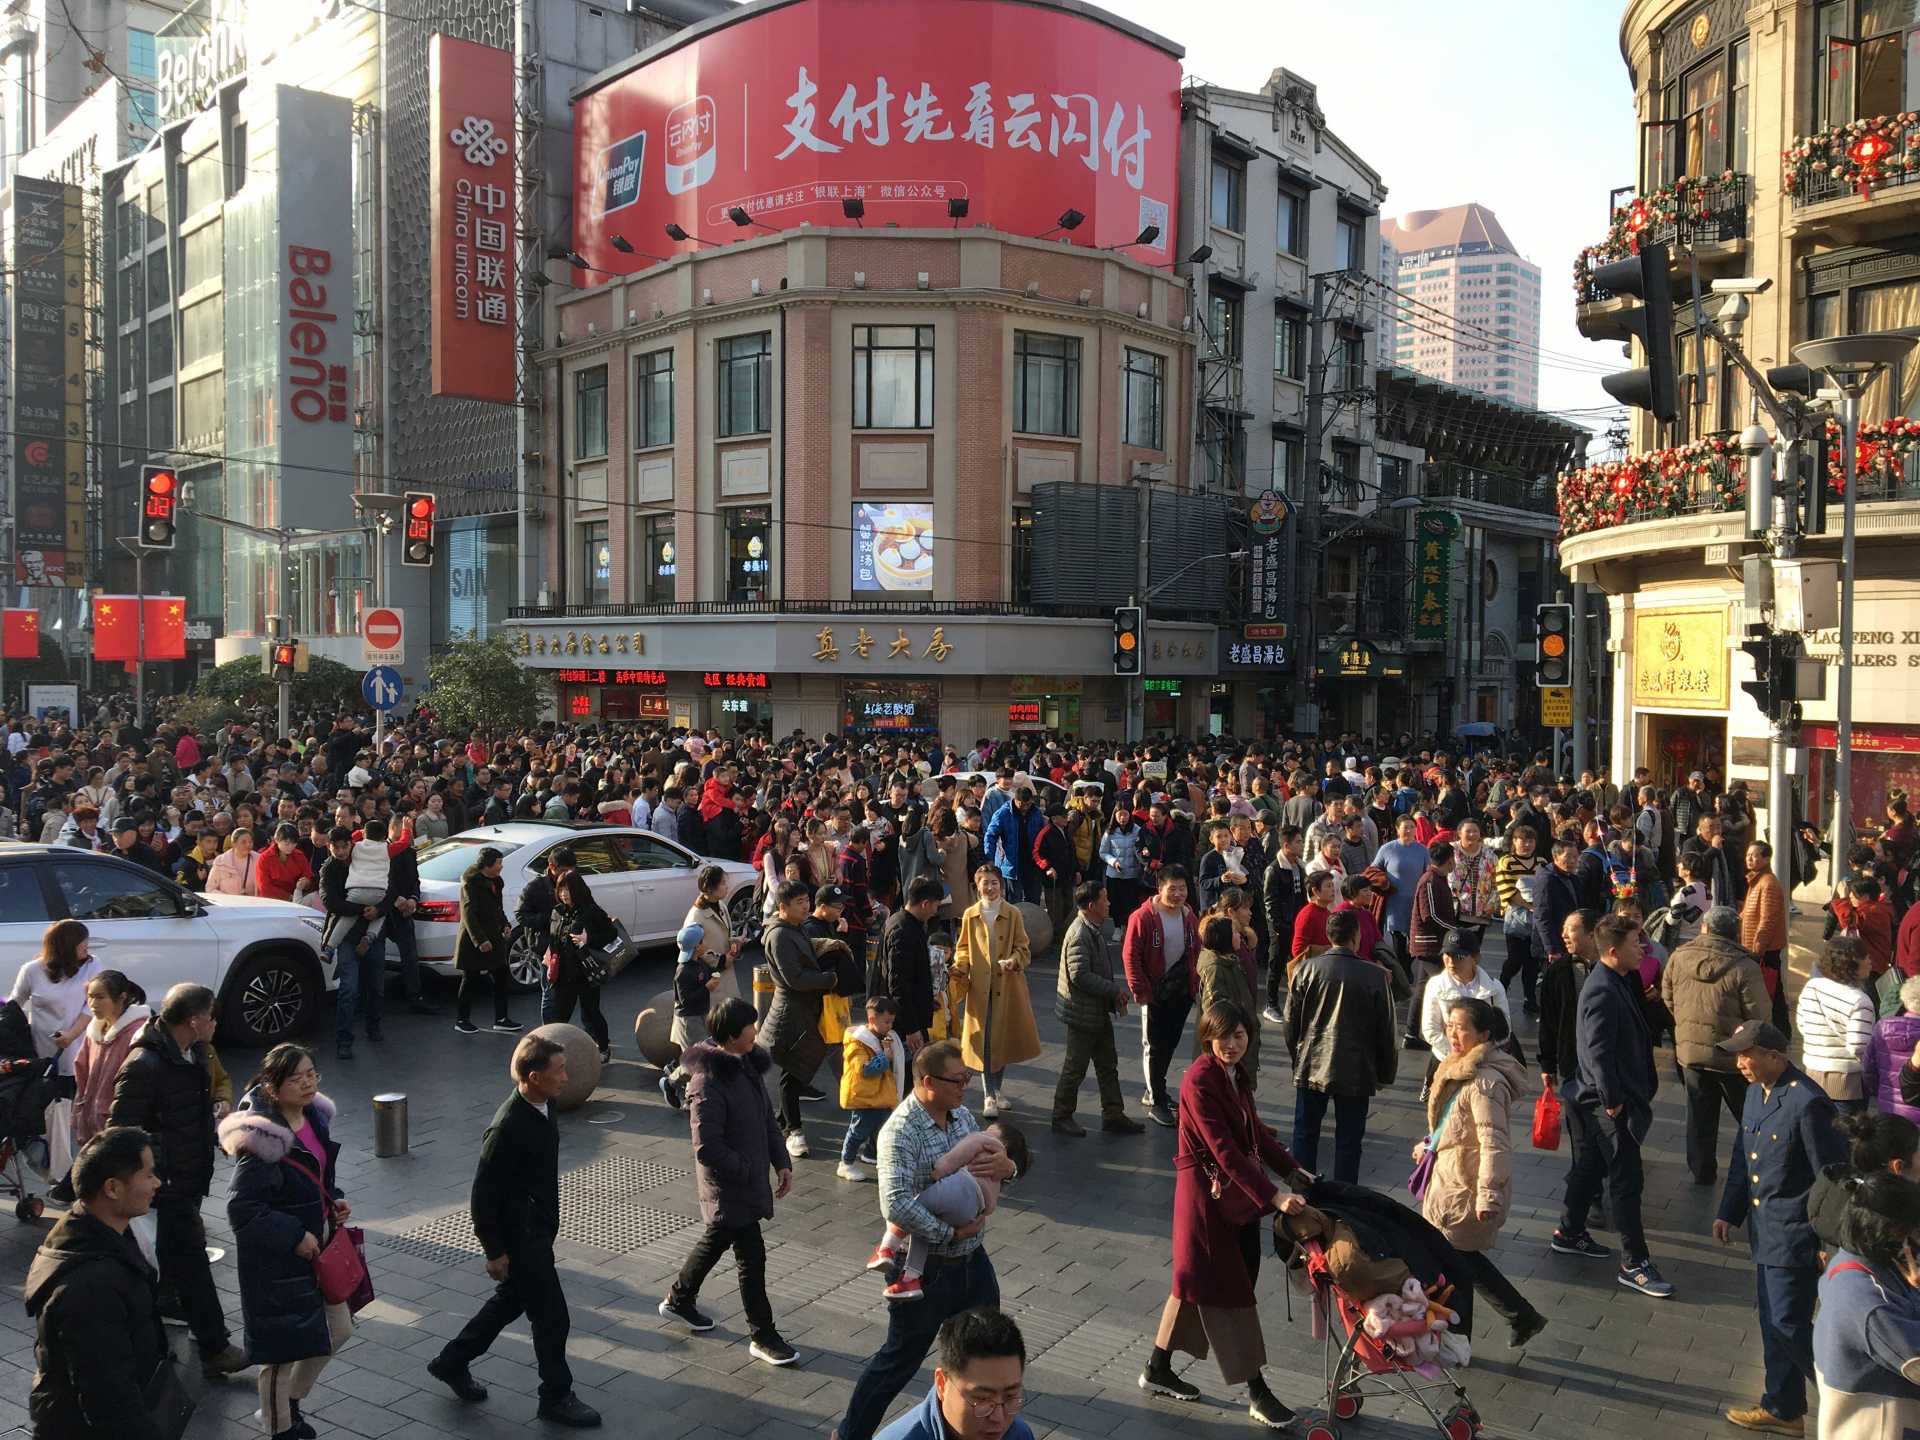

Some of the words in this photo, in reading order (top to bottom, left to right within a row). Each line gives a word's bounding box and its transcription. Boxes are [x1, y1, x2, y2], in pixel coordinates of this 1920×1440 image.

[669, 111, 710, 147] 云闪付
[774, 66, 1151, 189] 支付先看云闪付
[676, 141, 702, 158] UnionPay
[598, 155, 640, 184] UnionPay
[613, 173, 635, 197] 银联
[881, 185, 947, 198] 微信公众号
[455, 178, 470, 239] China
[21, 237, 54, 248] JEWELRY
[475, 183, 507, 325] 中国联通
[67, 273, 79, 289] 6
[455, 242, 469, 319] unicom
[21, 303, 59, 323] 陶瓷
[68, 322, 80, 337] 5
[288, 245, 337, 421] Baleno
[68, 373, 80, 388] 4
[20, 405, 60, 421] 珍珠城
[68, 420, 80, 437] 3
[68, 471, 80, 487] 2
[463, 471, 512, 493] SAMSUNG
[71, 520, 79, 534] 1
[859, 523, 873, 581] 蟹粉汤包
[45, 565, 64, 573] KFC
[66, 561, 84, 577] B1
[1253, 547, 1263, 613] 中华名小吃
[1264, 536, 1280, 620] 老盛昌湯包
[1251, 627, 1278, 636] 汤包馆
[519, 630, 645, 656] 真老大房食品公司
[812, 626, 954, 663] 真老大房
[1228, 643, 1285, 665] 老盛昌湯包
[725, 673, 766, 688] 经典黄浦
[722, 699, 749, 713] 关东煮
[863, 702, 906, 716] 上海老酸奶
[1634, 1273, 1648, 1285] N
